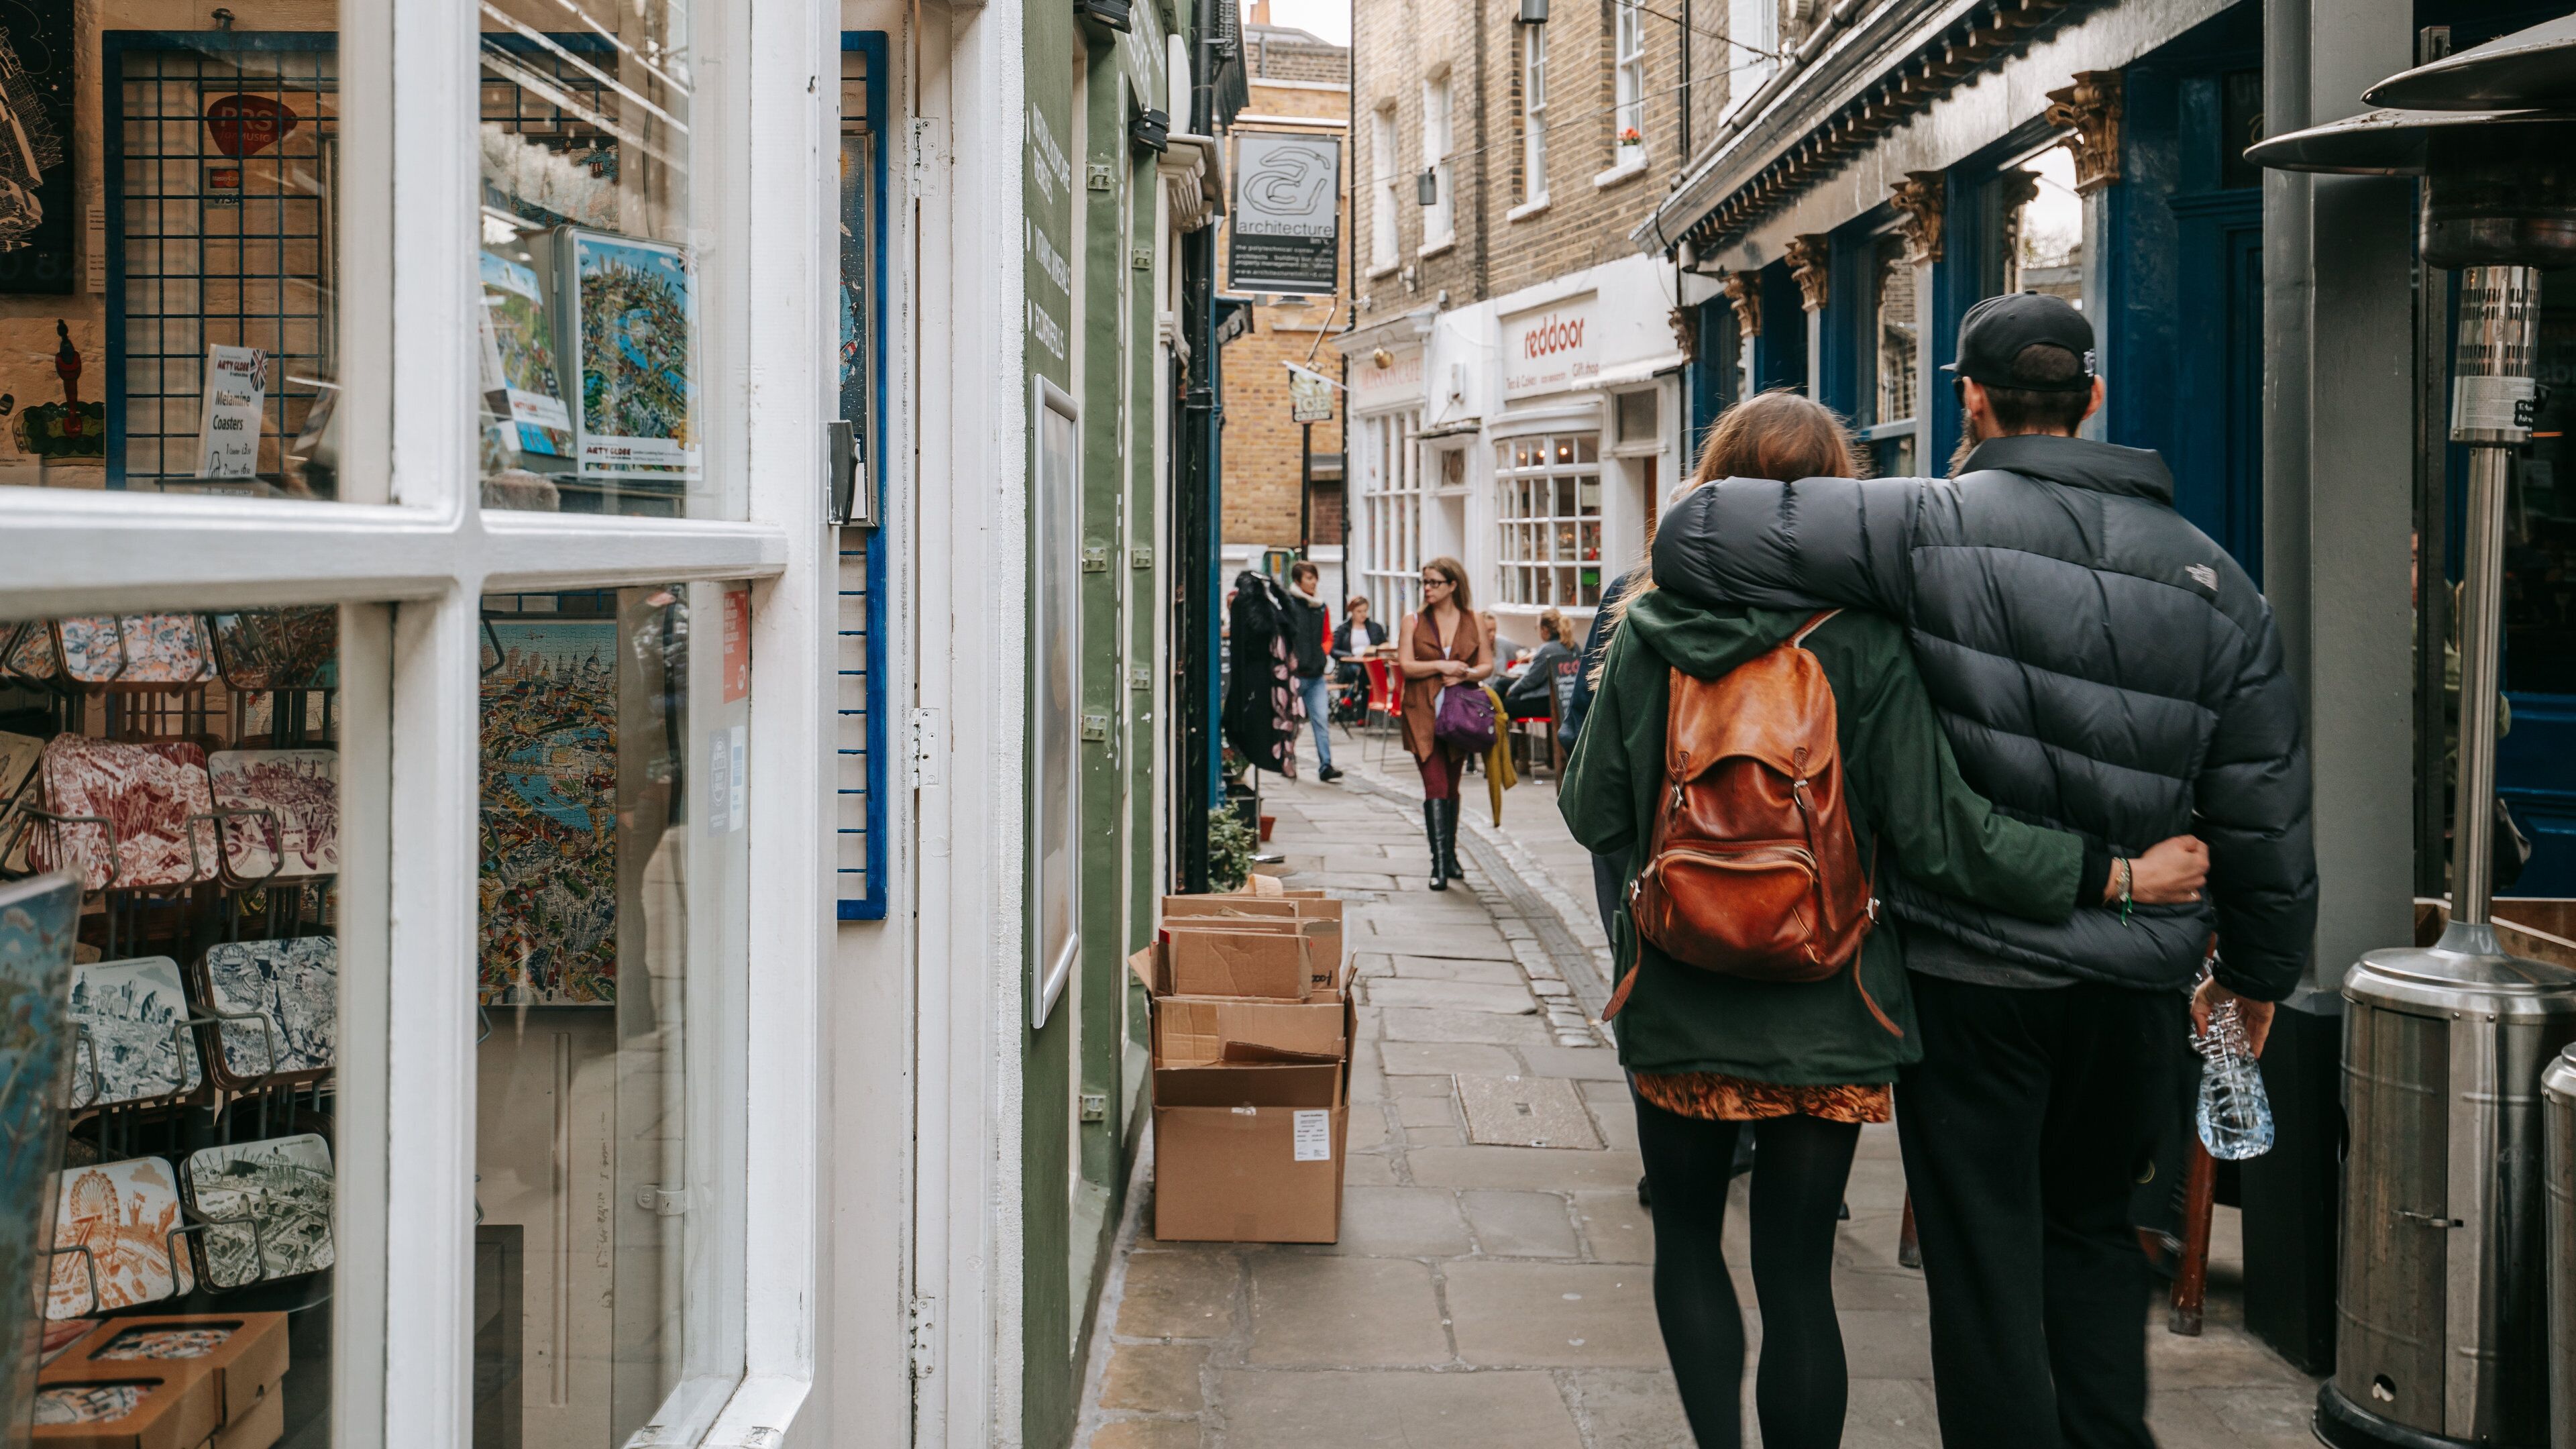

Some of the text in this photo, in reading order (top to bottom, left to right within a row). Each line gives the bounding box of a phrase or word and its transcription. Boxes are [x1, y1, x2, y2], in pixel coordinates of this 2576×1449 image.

[221, 106, 274, 131] PRS
[1238, 220, 1333, 236] architecture
[1525, 313, 1585, 360] reddoor
[217, 360, 233, 370] ARTY
[215, 390, 251, 407] Melamine
[1294, 396, 1330, 413] ICE
[213, 414, 244, 431] Coasters
[586, 446, 608, 455] ARTY
